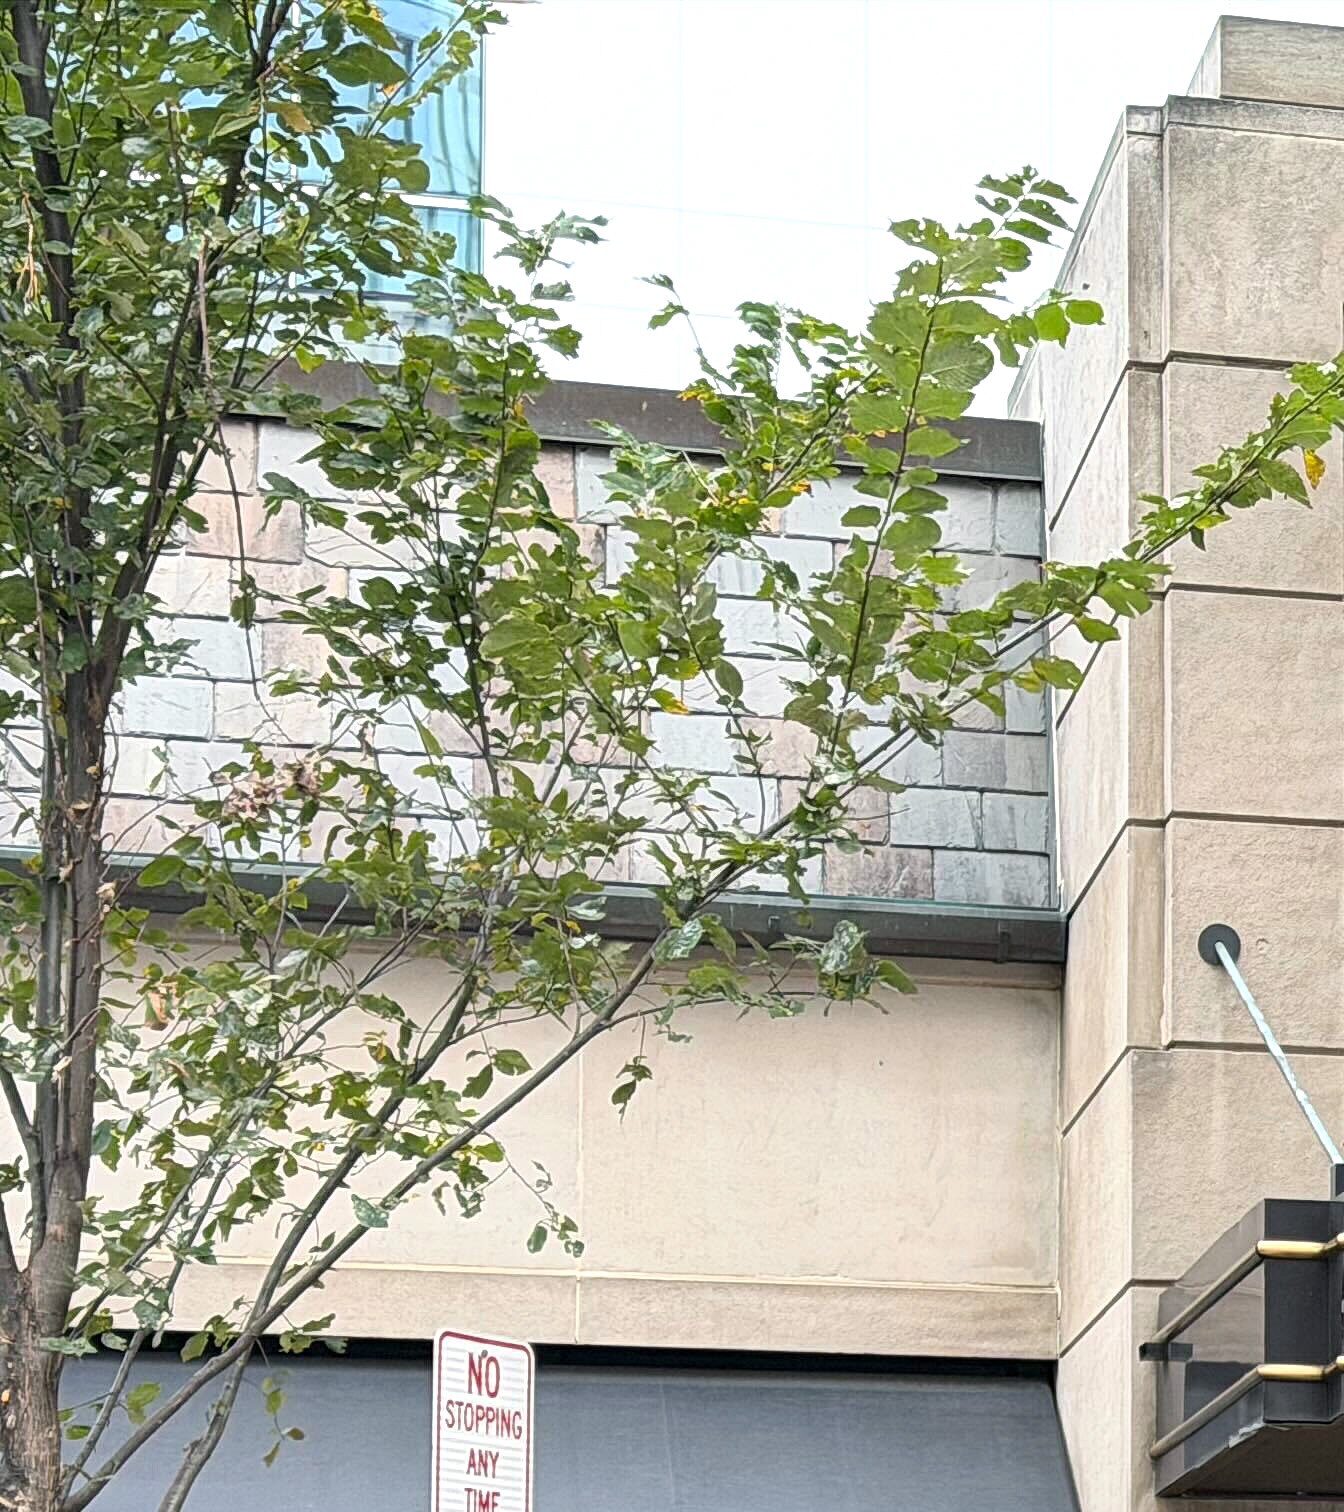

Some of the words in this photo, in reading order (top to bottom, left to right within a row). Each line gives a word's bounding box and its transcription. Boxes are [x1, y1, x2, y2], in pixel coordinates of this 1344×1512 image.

[467, 1351, 500, 1398] NO
[445, 1399, 522, 1440] STOPPING
[466, 1447, 499, 1478] ANY
